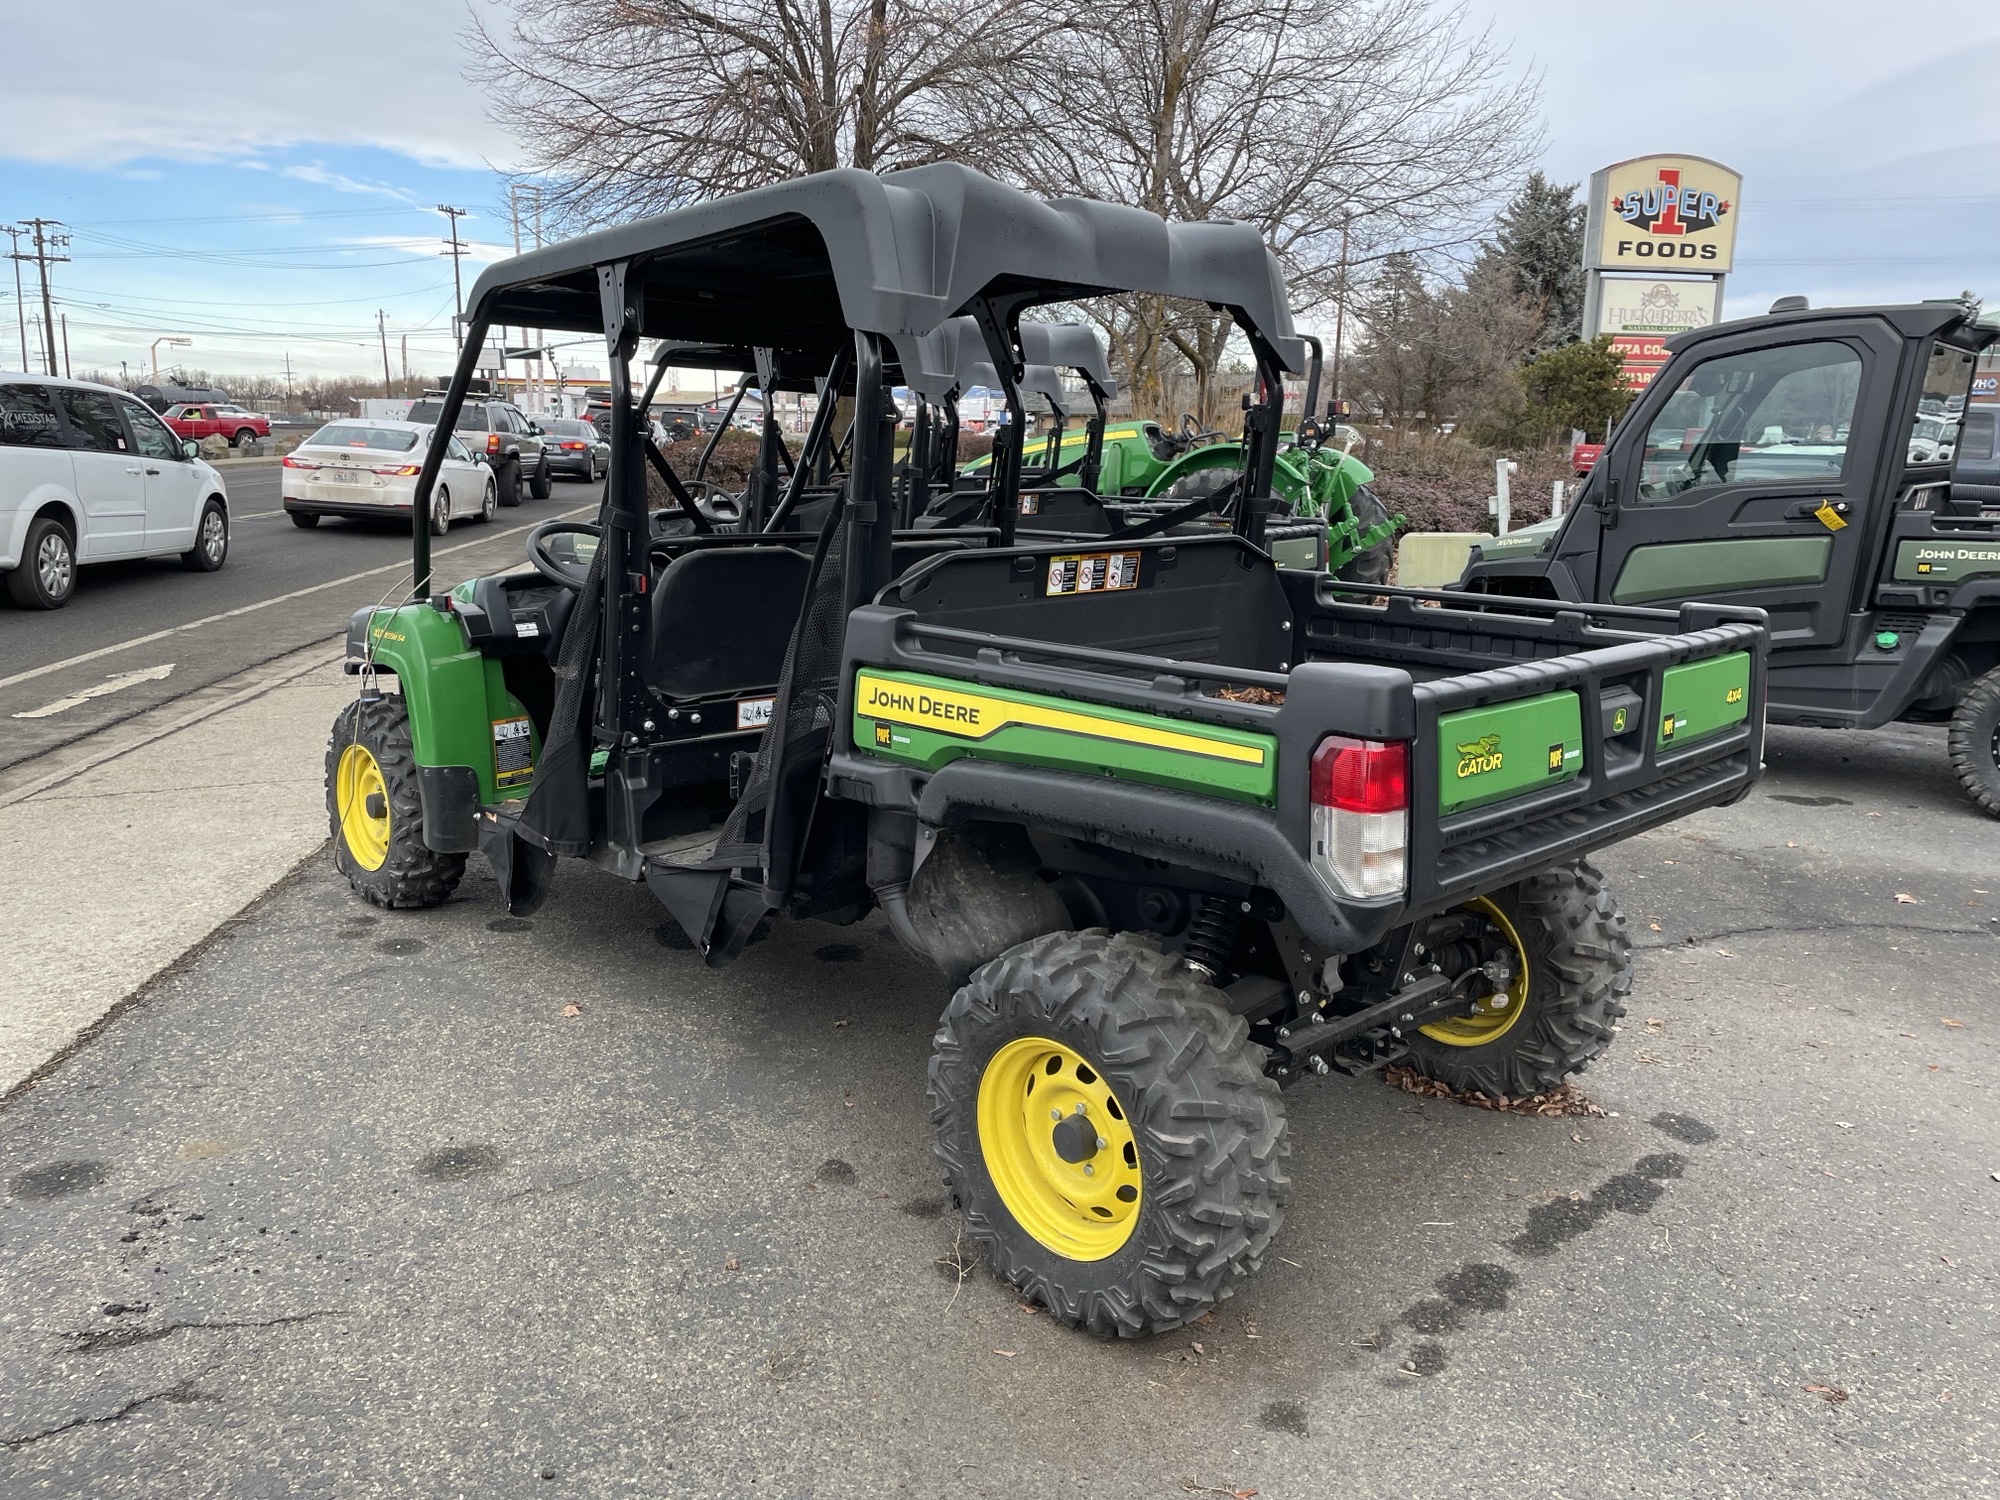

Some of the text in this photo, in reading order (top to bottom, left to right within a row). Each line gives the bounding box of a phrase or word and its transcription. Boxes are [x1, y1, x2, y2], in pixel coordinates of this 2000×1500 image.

[1621, 184, 1720, 226] SUPER
[1650, 168, 1685, 237] 1
[1618, 240, 1717, 260] FOODS
[13, 412, 58, 425] MEDSTAR
[1915, 548, 1955, 559] JOHN
[868, 687, 980, 725] JOHN DEERE
[1457, 752, 1503, 778] GATOR
